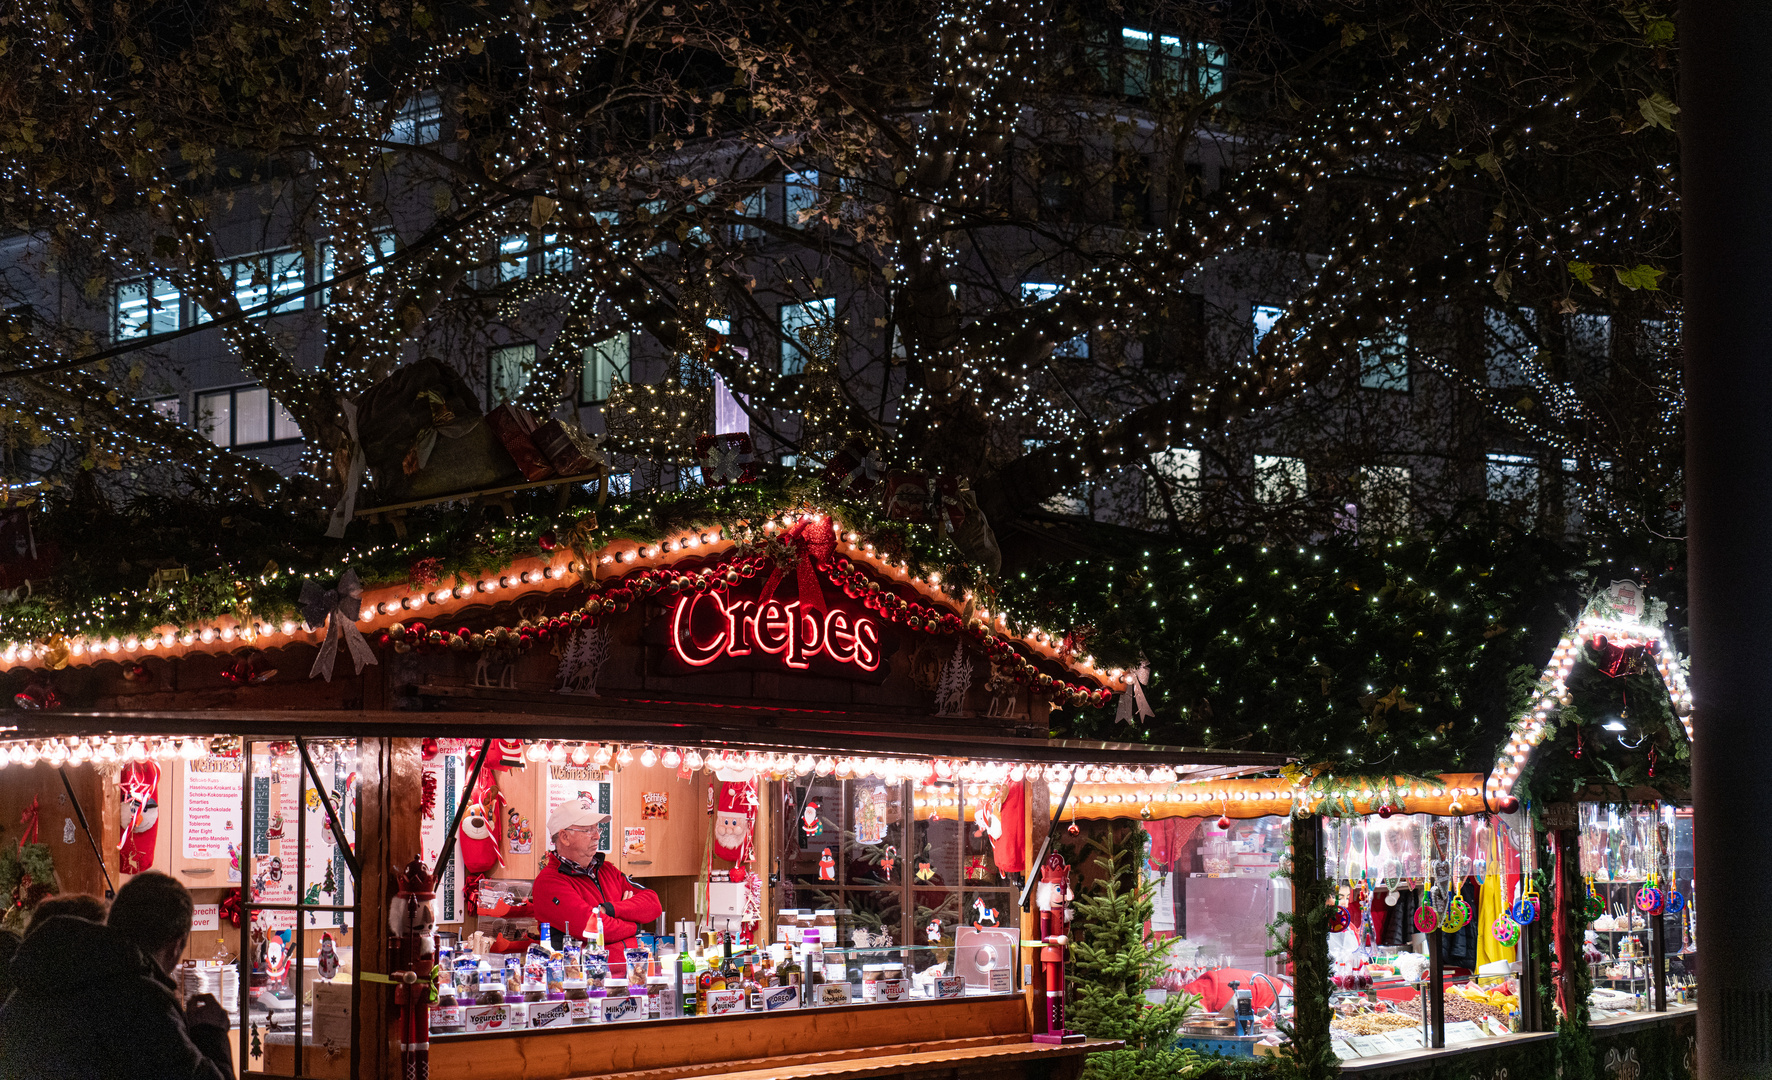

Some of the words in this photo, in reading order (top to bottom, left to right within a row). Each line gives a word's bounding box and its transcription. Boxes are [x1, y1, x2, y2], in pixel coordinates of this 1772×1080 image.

[881, 987, 905, 995] NUTELLA
[625, 1005, 637, 1013] Way
[537, 1011, 565, 1019] Snickers
[471, 1014, 506, 1025] Yogurette
